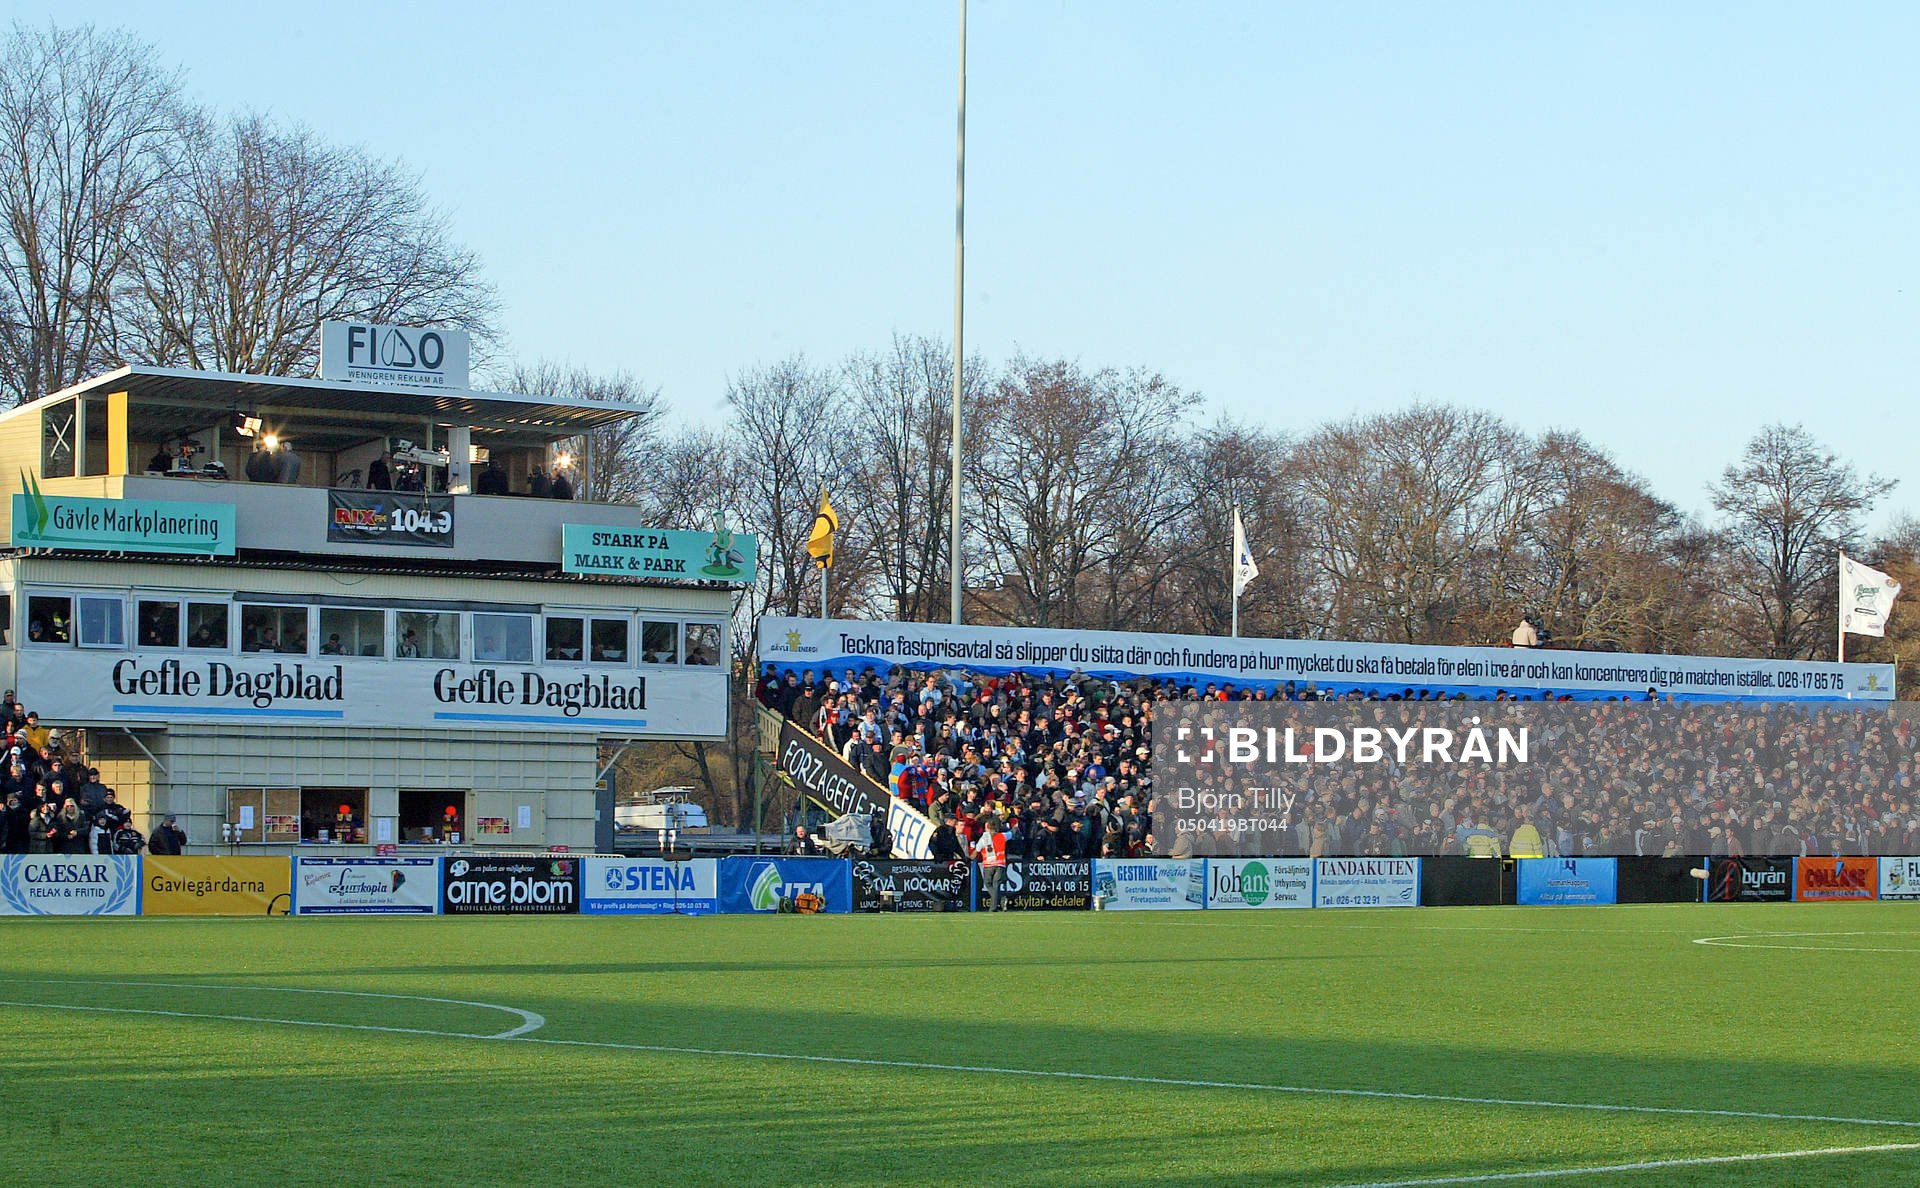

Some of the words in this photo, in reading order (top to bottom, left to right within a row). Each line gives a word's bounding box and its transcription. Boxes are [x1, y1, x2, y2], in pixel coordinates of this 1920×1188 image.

[348, 370, 395, 380] WENNGREN
[398, 373, 430, 384] REKLAM
[432, 376, 444, 384] AB
[54, 505, 99, 530] Gävle
[104, 508, 218, 540] Markplanering
[336, 508, 376, 525] RIX
[391, 508, 452, 534] 104.9
[592, 532, 644, 548] STARK
[648, 532, 669, 550] PÅ
[574, 554, 624, 570] MARK
[628, 556, 640, 570] &
[644, 558, 686, 572] PARK
[840, 634, 894, 655] Teckna
[898, 636, 992, 660] fastprisavtal
[995, 640, 1014, 660] så
[1016, 641, 1066, 664] slipper
[1070, 643, 1088, 662] du
[1092, 645, 1124, 664] sitta
[1126, 646, 1151, 665] där
[1154, 648, 1180, 667] och
[1183, 648, 1237, 669] fundera
[1240, 650, 1256, 672] på
[1260, 651, 1284, 670] hur
[1286, 654, 1334, 674] mycket
[1337, 655, 1352, 673] du
[1356, 656, 1378, 674] ska
[1381, 656, 1394, 675] få
[1396, 658, 1434, 676] betala
[1438, 658, 1454, 676] för
[1458, 660, 1482, 677] elen
[1485, 660, 1488, 677] i
[1491, 660, 1508, 678] tre
[1512, 659, 1524, 678] år
[1528, 661, 1549, 678] och
[1552, 662, 1572, 680] kan
[1576, 664, 1647, 682] koncentrera
[1650, 667, 1667, 687] dig
[1670, 666, 1684, 687] på
[1686, 668, 1734, 686] matchen
[1736, 670, 1776, 688] istället.
[1814, 672, 1828, 690] 85
[1830, 674, 1844, 690] 75
[112, 658, 200, 696] Gefle
[206, 662, 344, 708] Dagblad
[434, 668, 514, 704] Gefle
[520, 672, 647, 717] Dagblad
[24, 864, 110, 883] CAESAR
[892, 866, 932, 874] RESTAURANG
[1029, 863, 1078, 876] SCREENTRYCK
[1079, 863, 1088, 876] AB
[1117, 866, 1158, 881] GESTRIKE
[1274, 864, 1310, 876] Försäljning
[1320, 861, 1414, 876] TANDAKUTEN
[1742, 866, 1786, 888] byrån
[151, 875, 265, 896] Gavlegårdarna
[626, 866, 696, 891] STENA
[873, 876, 896, 891] TVÅ
[904, 878, 950, 892] KOCKAR
[1029, 882, 1061, 892] 026-14
[1064, 882, 1076, 892] 08
[1079, 881, 1089, 892] 15
[1210, 865, 1270, 901] Johans
[1274, 880, 1306, 889] Uthyrning
[30, 888, 60, 897] RELAX
[64, 888, 72, 898] &
[74, 888, 105, 898] FRITID
[448, 881, 506, 904] arne
[510, 876, 572, 904] blom
[1274, 892, 1296, 900] Service
[1014, 894, 1044, 909] skyltar
[1050, 895, 1086, 907] dekaler
